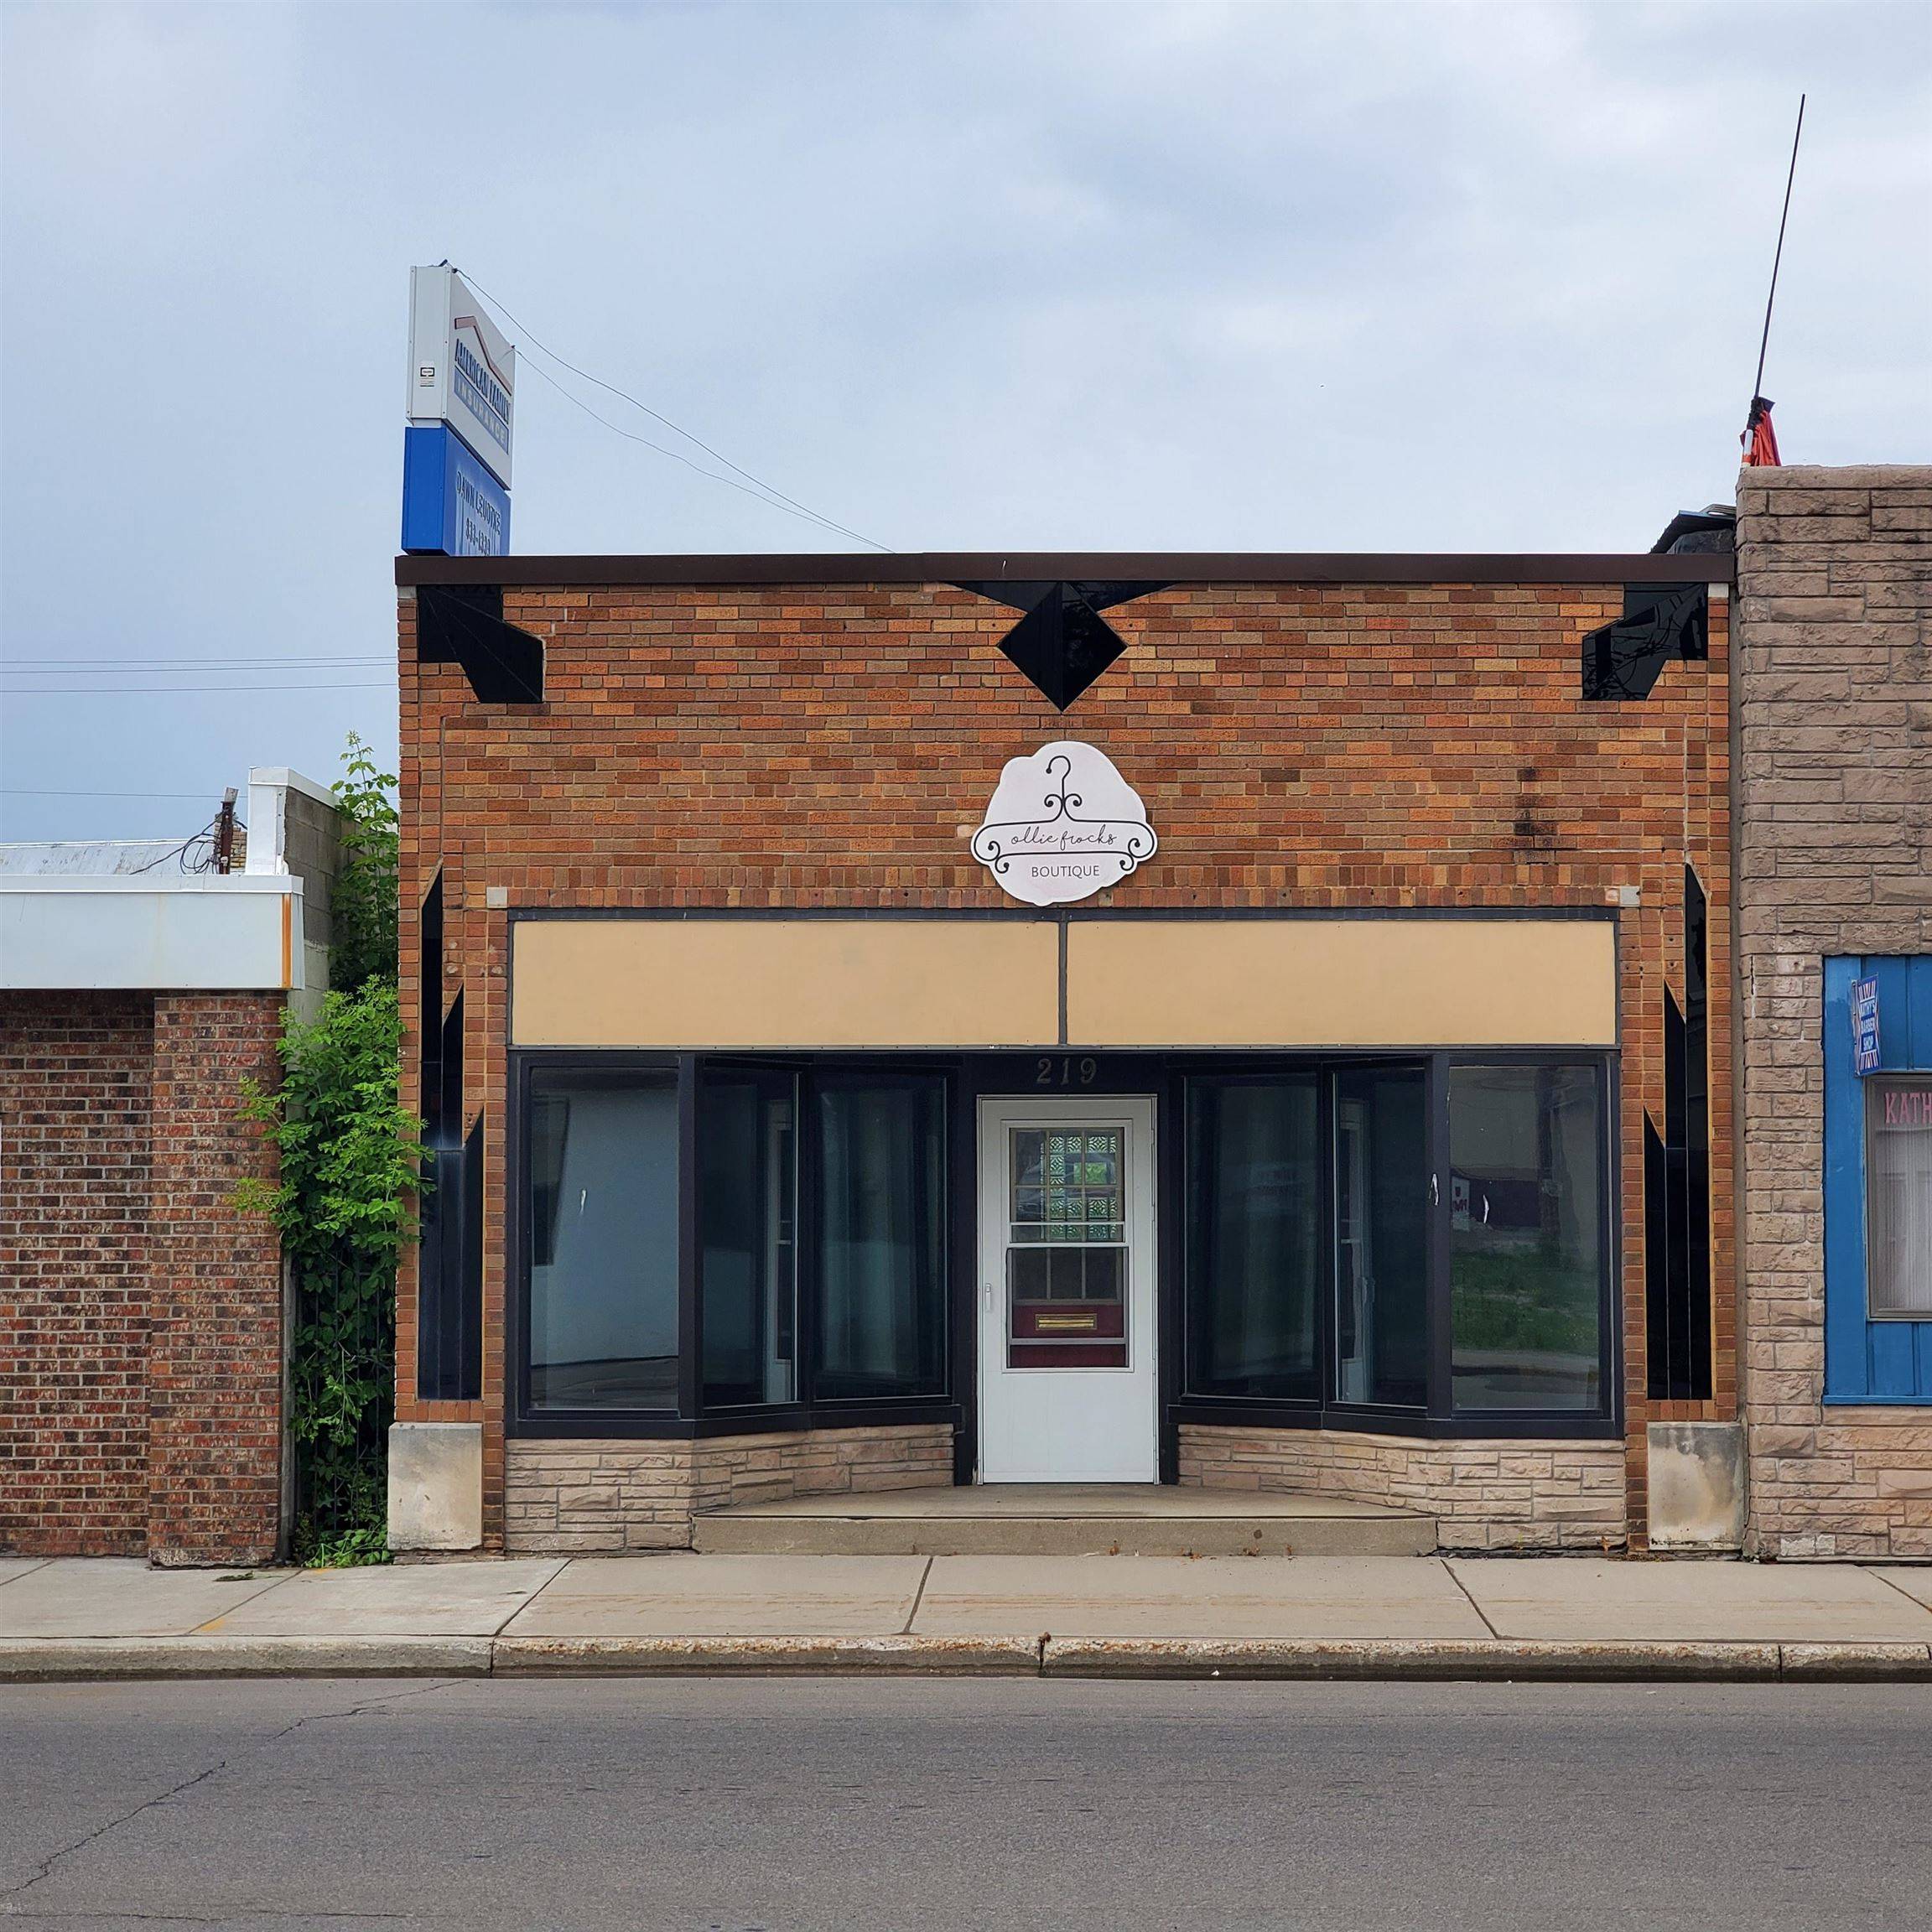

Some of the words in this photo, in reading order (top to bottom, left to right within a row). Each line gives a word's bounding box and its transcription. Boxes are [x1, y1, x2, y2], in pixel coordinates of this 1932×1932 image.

[454, 338, 489, 398] AMERICAN
[489, 378, 511, 425] FAMILY
[457, 376, 506, 444] INSURANCE
[457, 471, 475, 509] DAWN
[1011, 826, 1058, 844] ollie
[1058, 823, 1117, 851] frocks
[1031, 865, 1100, 879] BOUTIQUE
[1860, 1017, 1875, 1035] BARBER
[1863, 1036, 1874, 1052] SHOP
[1036, 1057, 1097, 1085] 219
